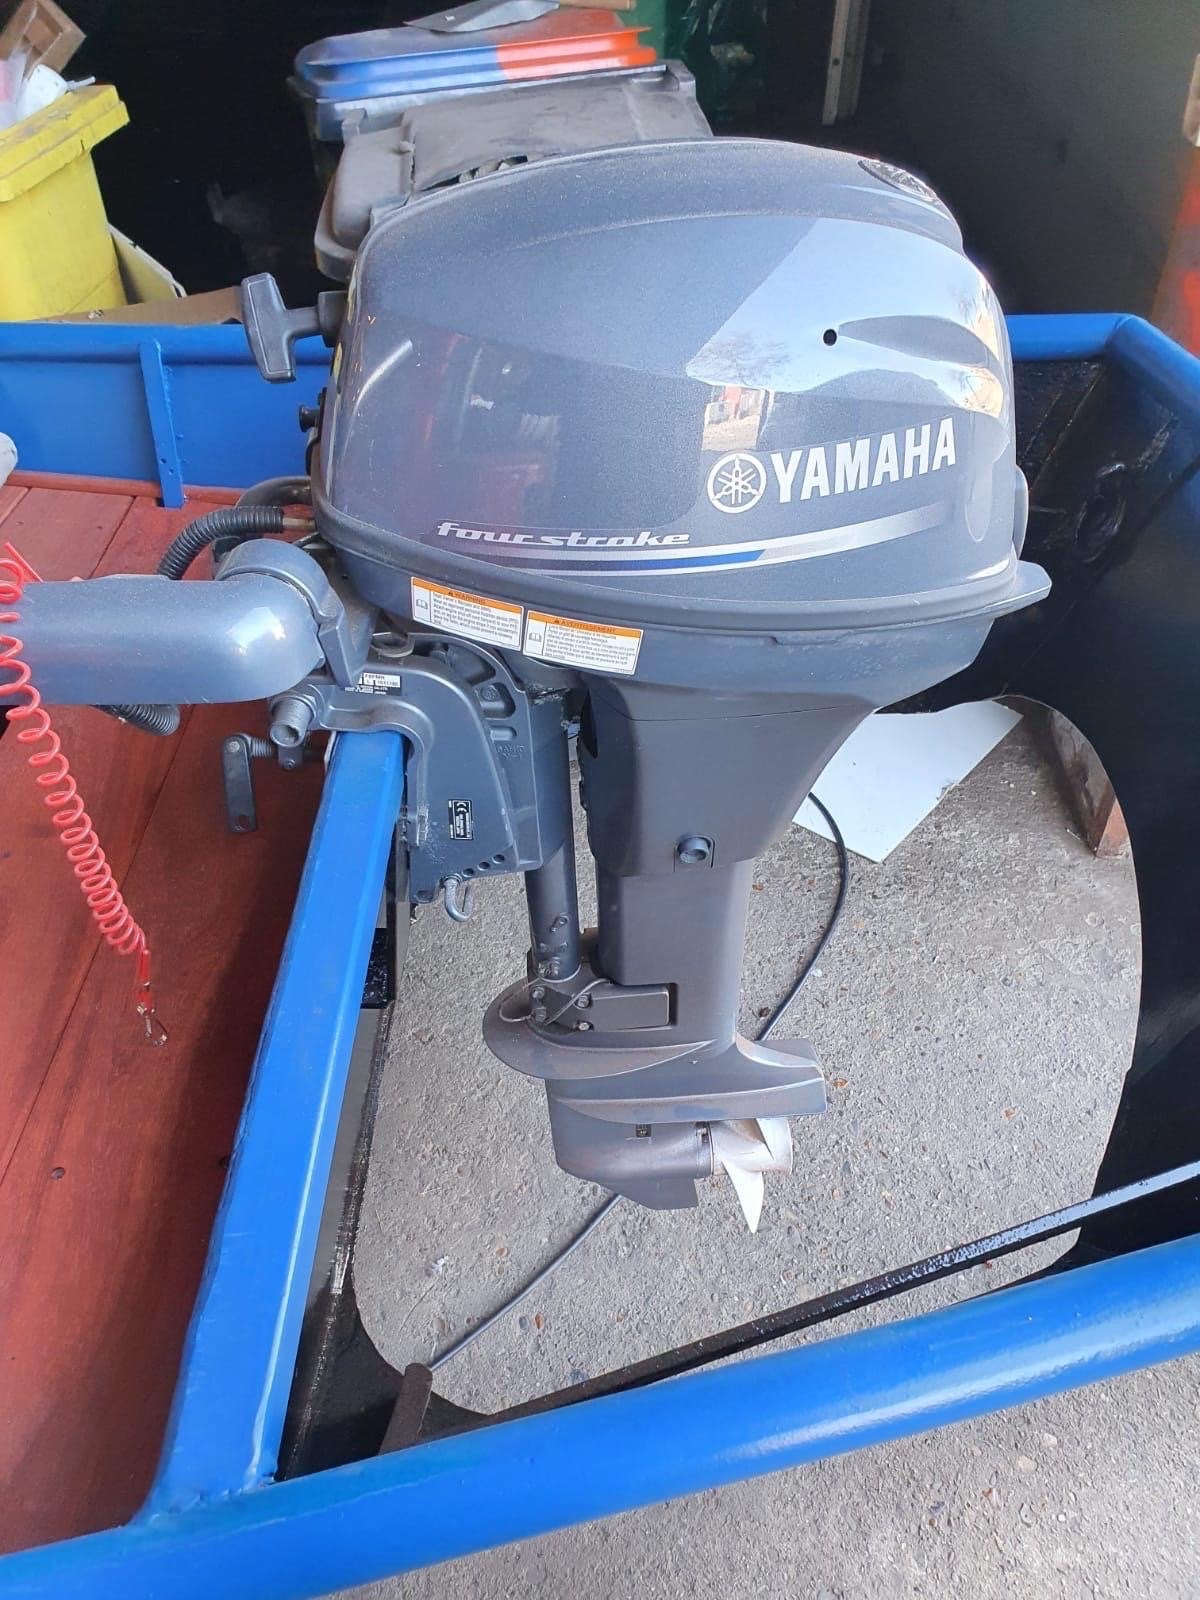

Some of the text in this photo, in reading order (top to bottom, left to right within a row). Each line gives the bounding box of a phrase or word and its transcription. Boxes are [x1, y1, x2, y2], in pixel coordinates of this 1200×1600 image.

[770, 417, 956, 504] YAMAHA
[437, 522, 690, 547] four stroke
